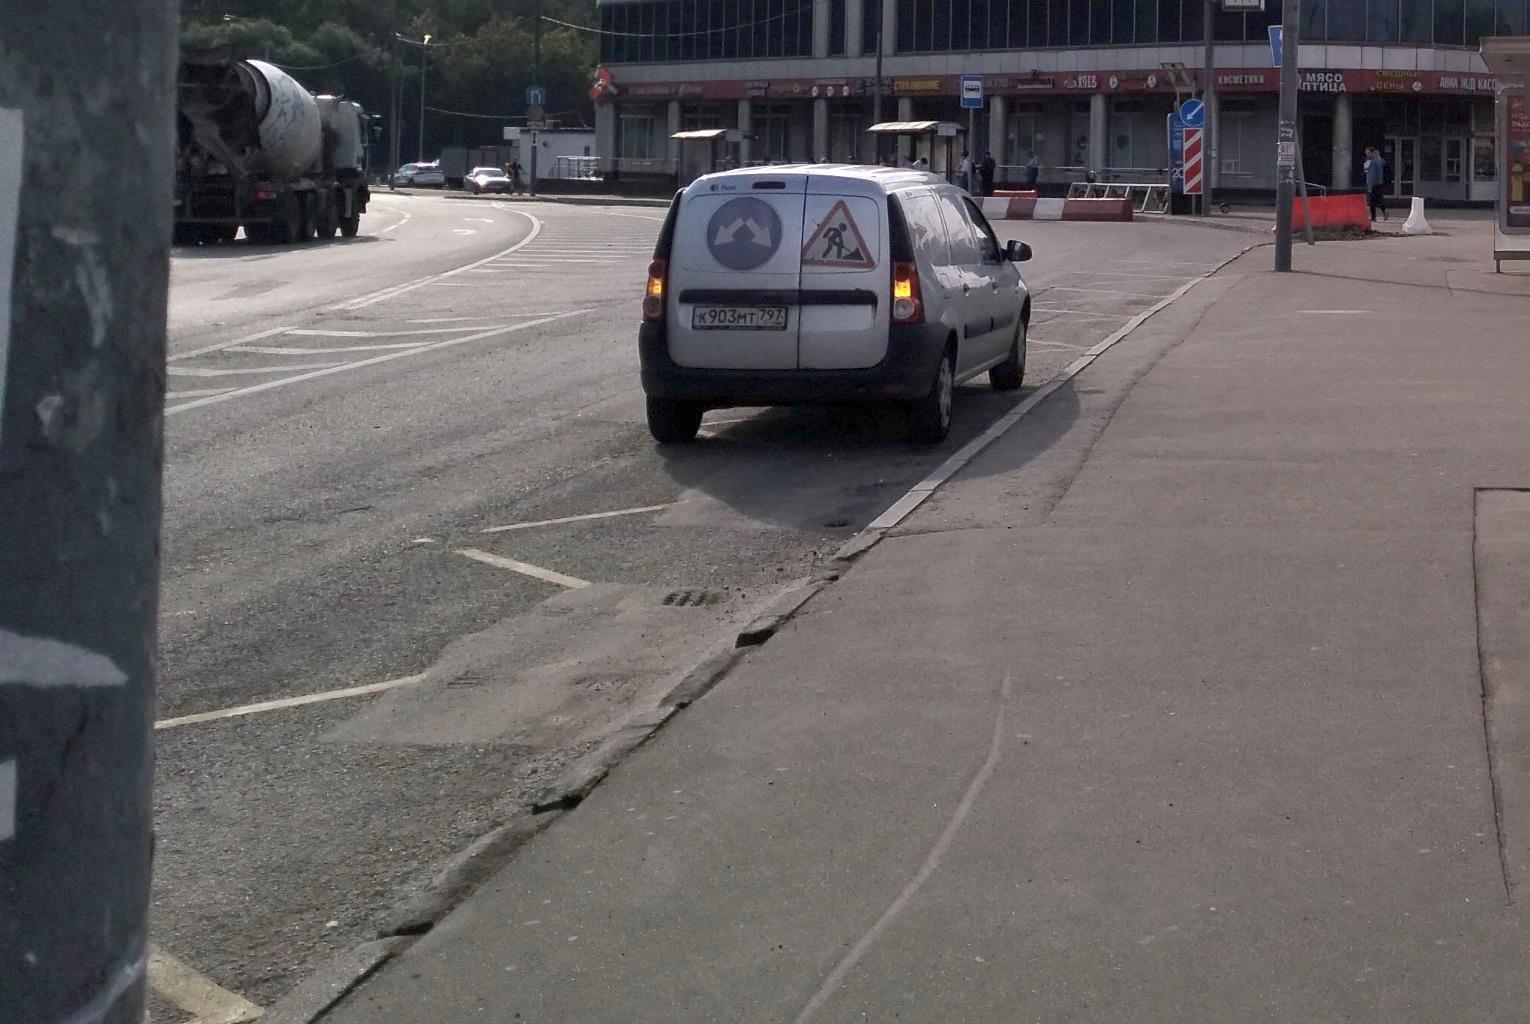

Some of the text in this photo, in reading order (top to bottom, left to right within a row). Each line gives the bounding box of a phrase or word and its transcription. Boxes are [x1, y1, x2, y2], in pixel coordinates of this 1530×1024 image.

[1305, 72, 1343, 83] МЯСО
[1302, 82, 1347, 93] ПТИЦА
[759, 307, 783, 321] 797
